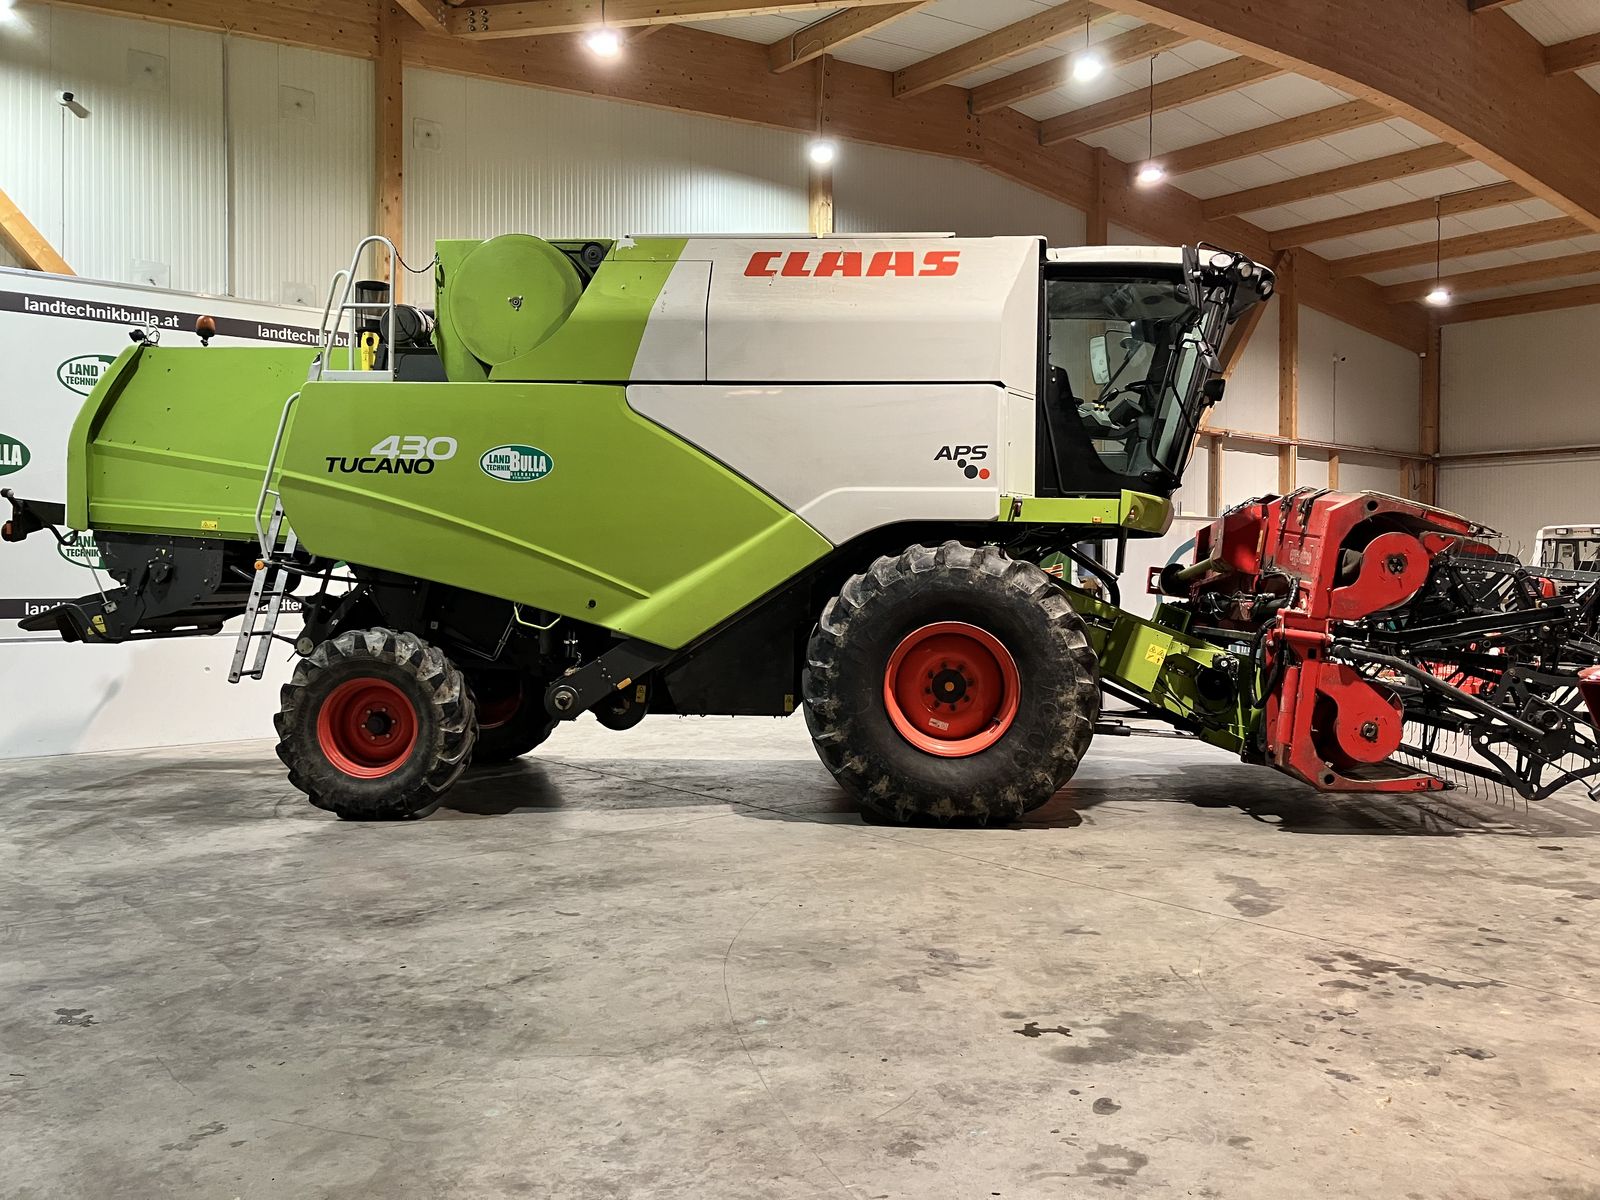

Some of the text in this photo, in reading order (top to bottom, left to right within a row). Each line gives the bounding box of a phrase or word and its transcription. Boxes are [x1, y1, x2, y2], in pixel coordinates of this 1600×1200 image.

[744, 251, 960, 277] CLAAS
[24, 296, 180, 328] landtechnikbulla.at
[69, 363, 99, 376] LAND
[65, 376, 99, 386] TECHNIK
[370, 435, 458, 461] 430
[933, 445, 988, 461] APS
[326, 456, 435, 475] TUCANO
[489, 454, 511, 464] LAND
[510, 450, 547, 472] BULLA
